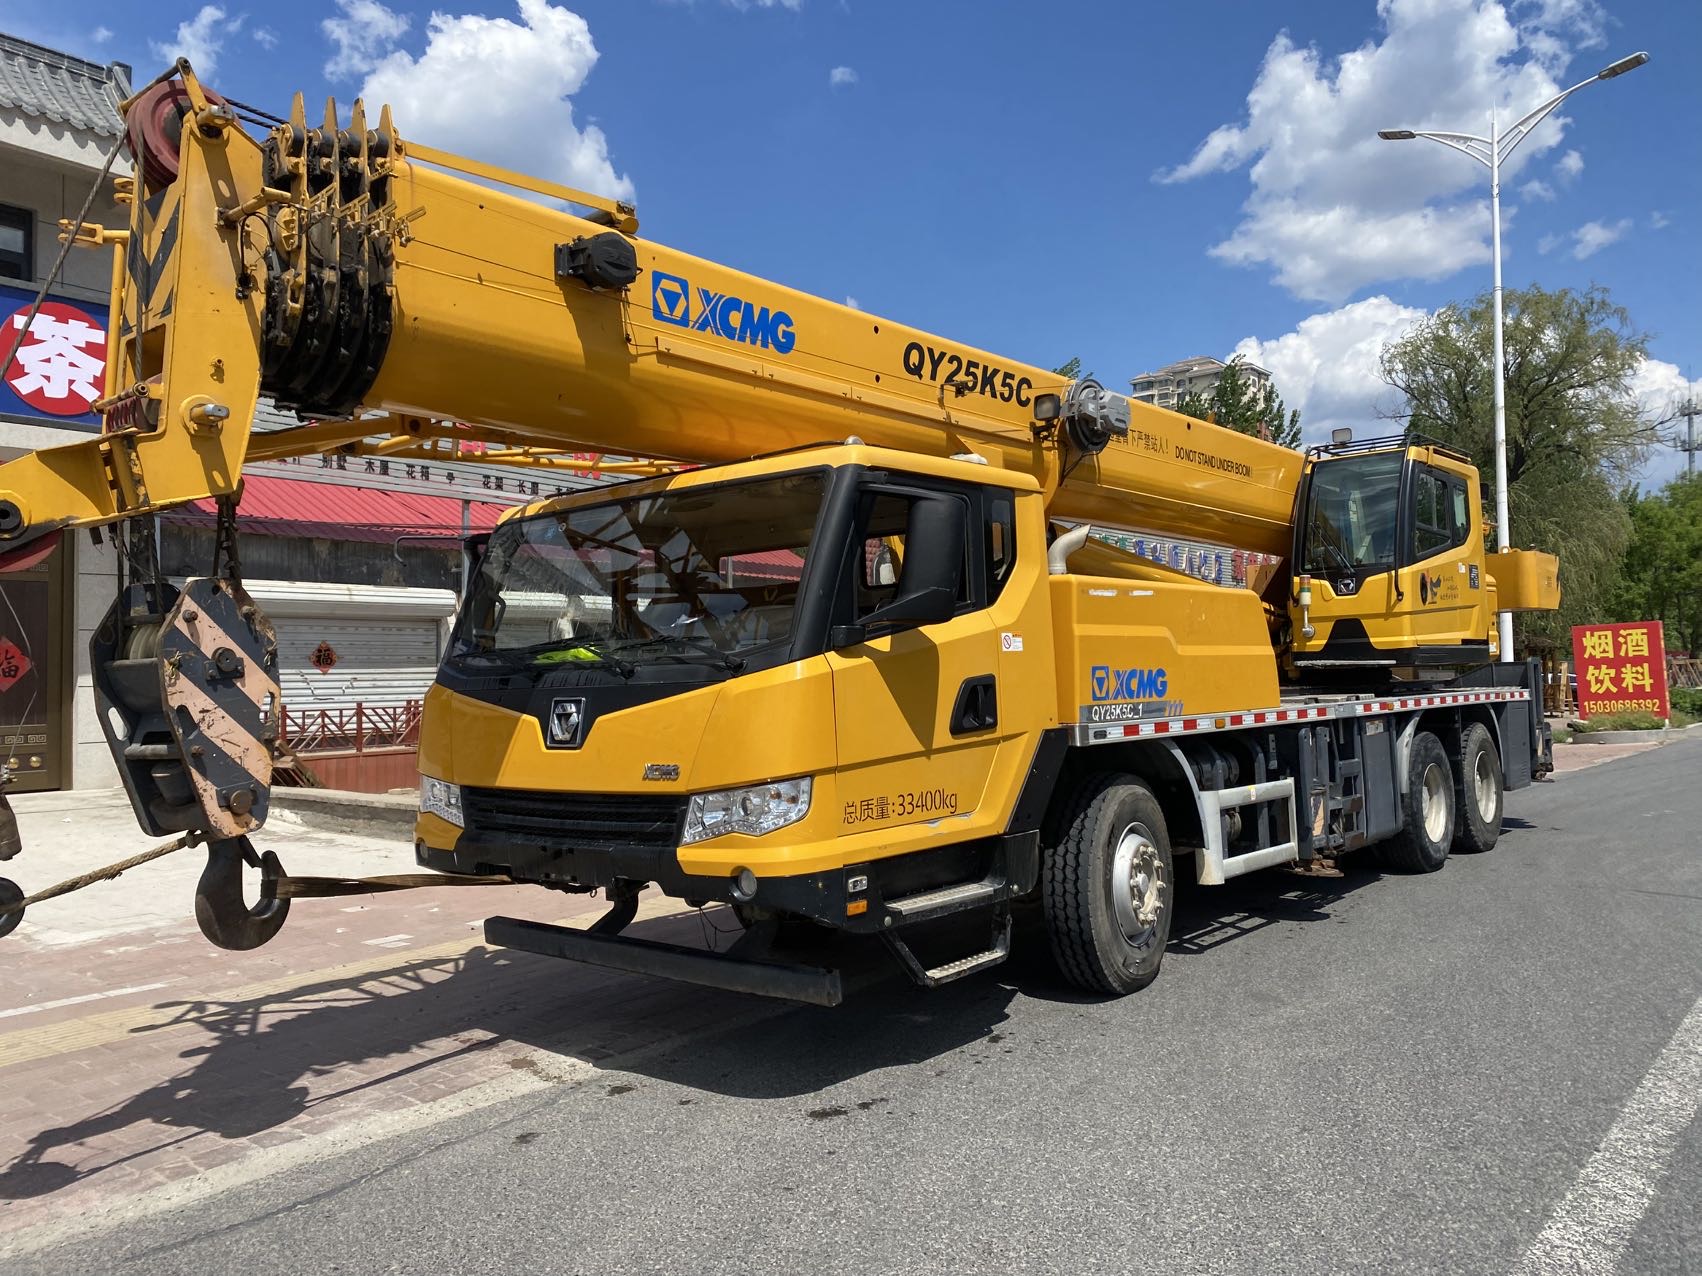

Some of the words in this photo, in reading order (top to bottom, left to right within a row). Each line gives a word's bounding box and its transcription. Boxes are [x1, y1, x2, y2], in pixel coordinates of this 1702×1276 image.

[690, 287, 796, 354] XCMG
[10, 312, 106, 403] 茶
[903, 341, 1033, 408] QY25K5C
[1175, 445, 1185, 460] DO
[1185, 450, 1198, 464] NOT
[1197, 453, 1216, 469] STAND
[1216, 458, 1235, 474] UNDER
[1582, 628, 1649, 659] 烟酒
[1110, 668, 1168, 700] XCMG
[1586, 663, 1654, 694] 饮料
[1583, 699, 1660, 713] 15030686392
[843, 788, 958, 825] 总质量:33400kg
